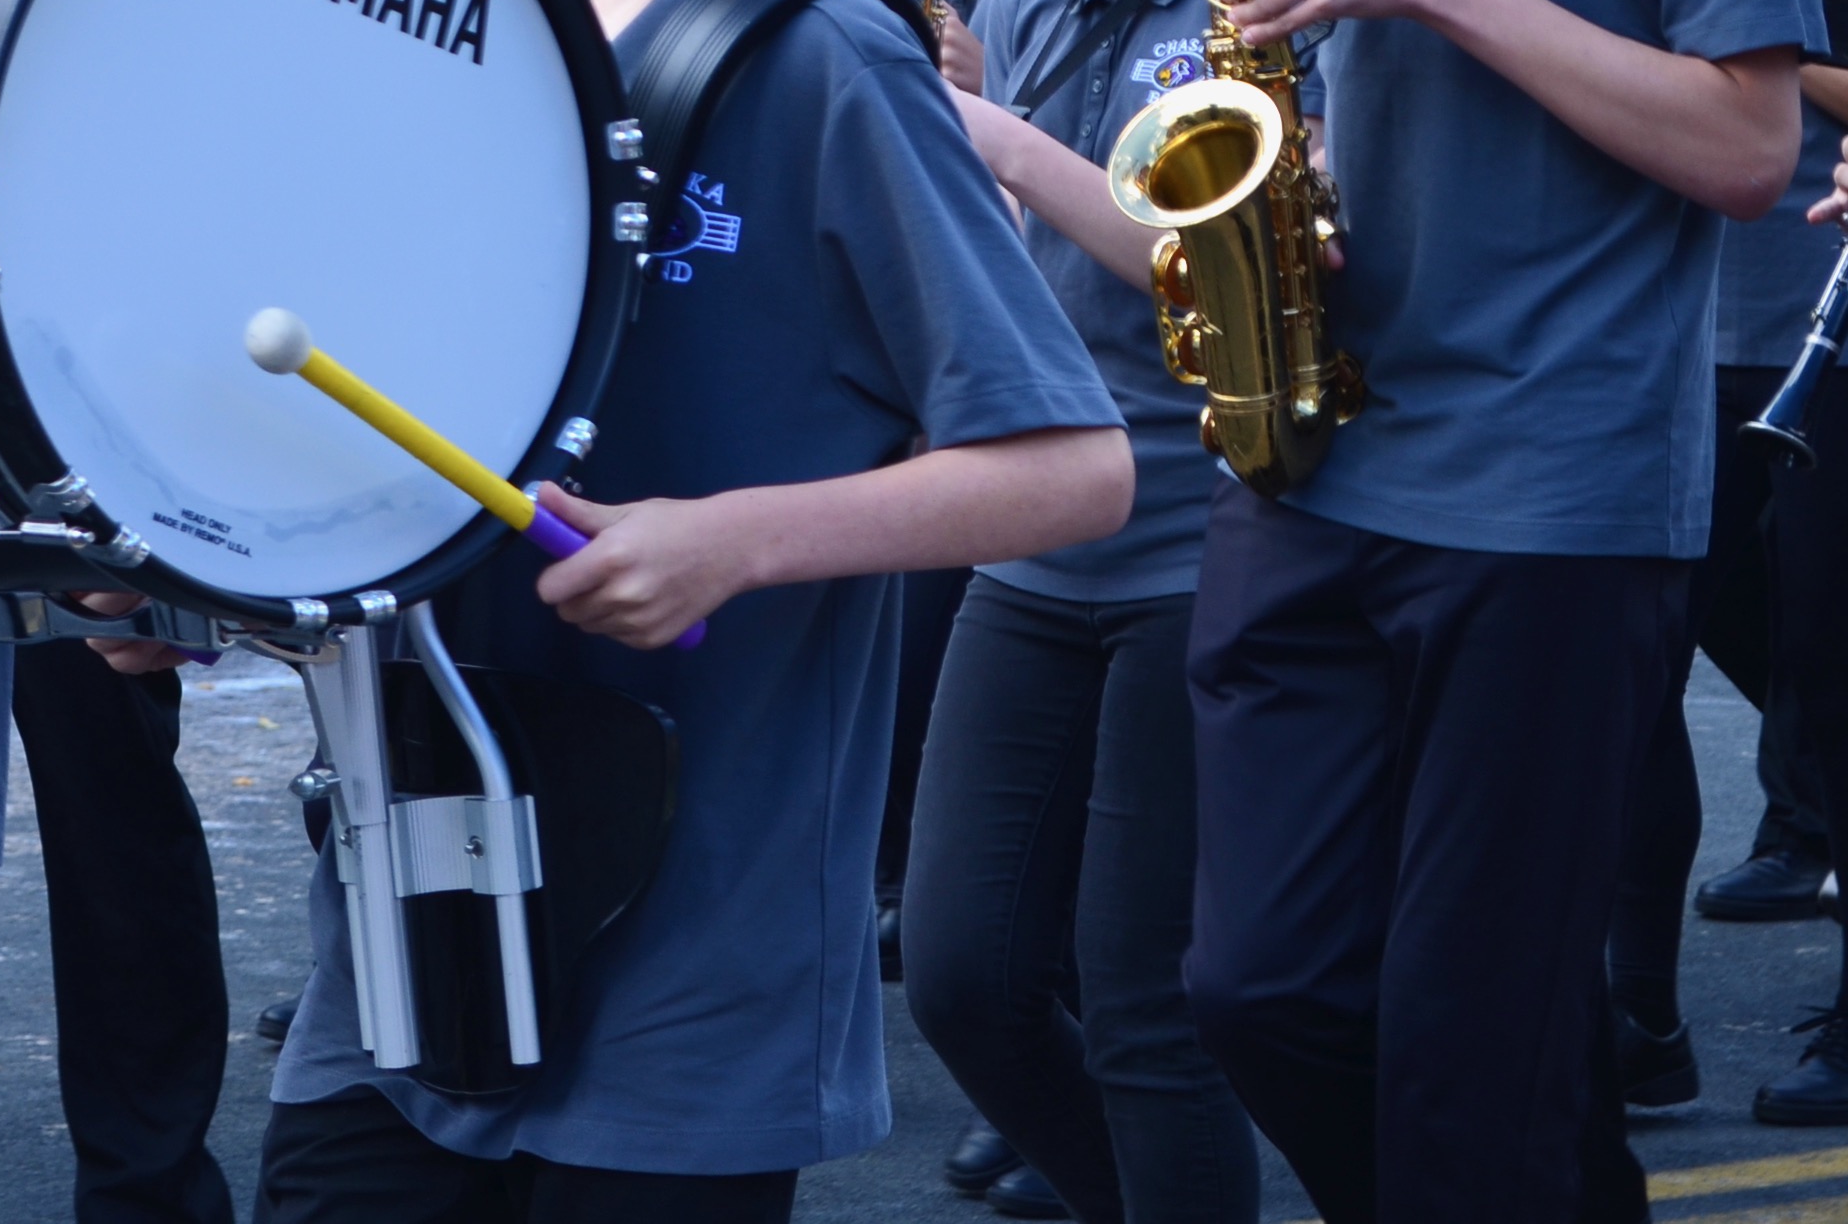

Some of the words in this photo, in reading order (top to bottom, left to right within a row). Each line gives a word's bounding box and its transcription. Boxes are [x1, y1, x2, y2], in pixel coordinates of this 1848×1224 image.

[1153, 37, 1205, 57] CHAS
[153, 512, 178, 529] MADE
[181, 508, 207, 525] HEAD
